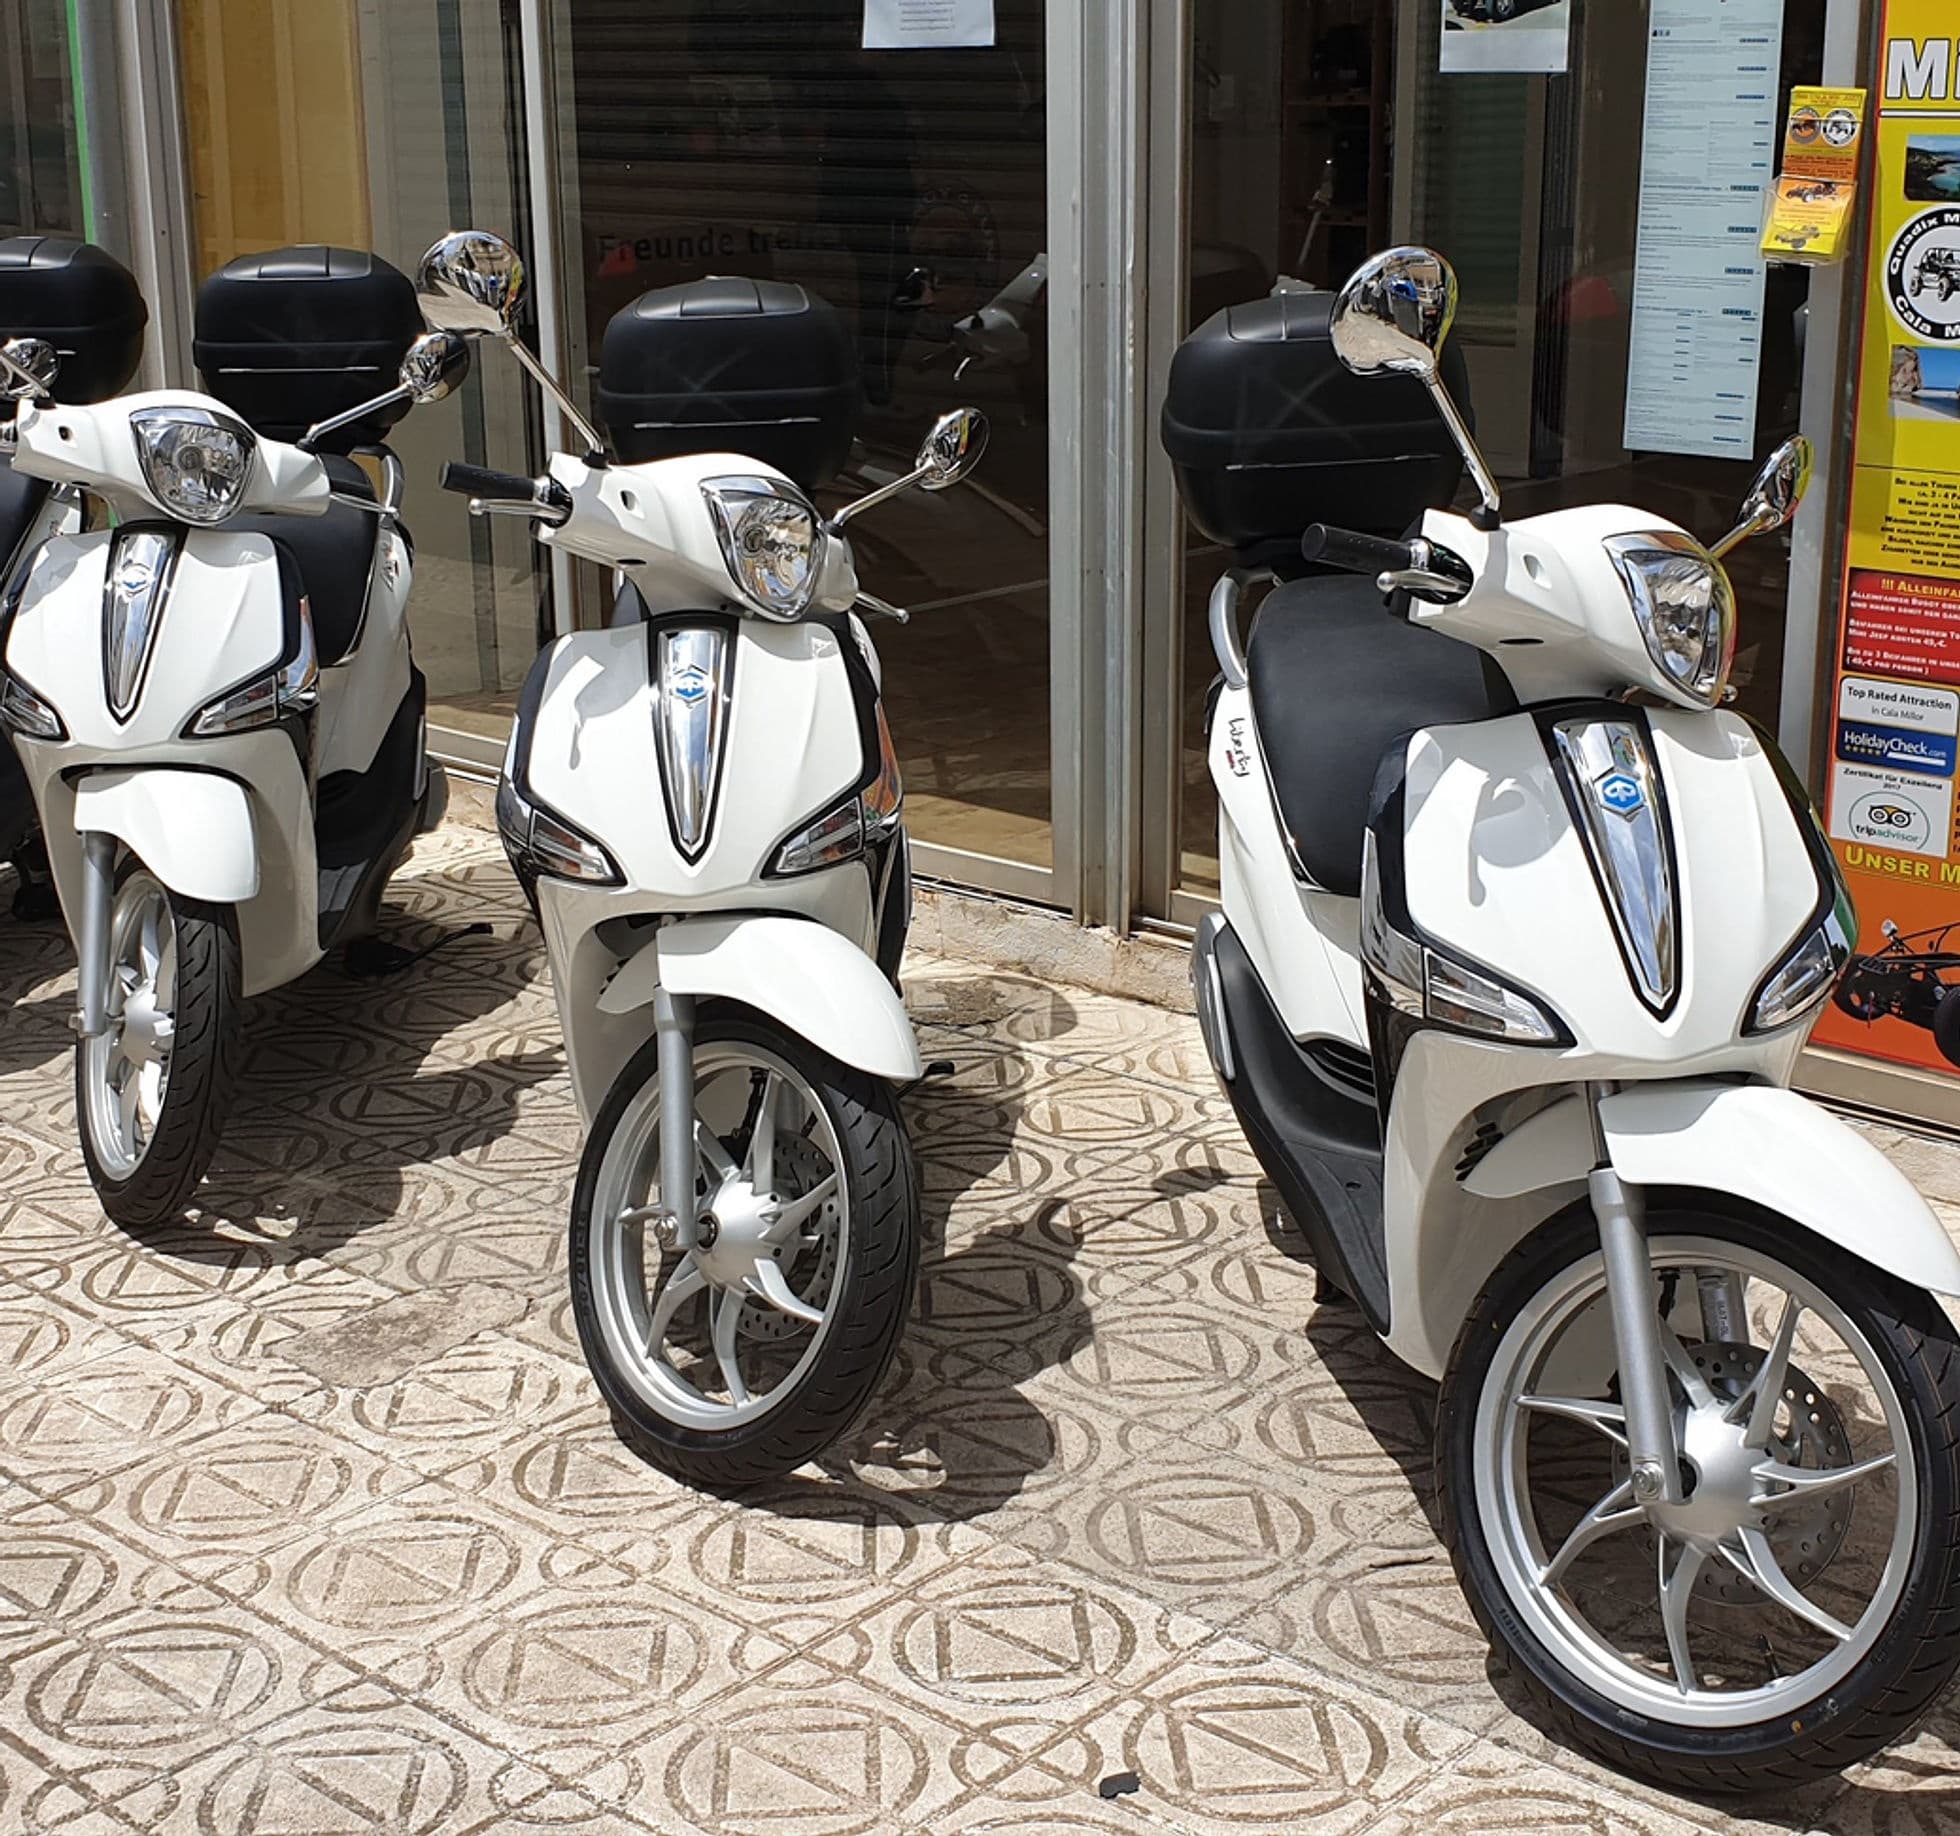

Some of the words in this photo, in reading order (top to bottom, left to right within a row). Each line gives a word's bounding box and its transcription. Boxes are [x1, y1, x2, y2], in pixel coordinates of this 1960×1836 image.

[598, 227, 734, 263] Freunde
[1890, 216, 1939, 276] Quadix
[1895, 294, 1932, 335] Cala
[1897, 580, 1960, 598] ALLEINFA
[1847, 685, 1866, 699] Top
[1867, 689, 1898, 702] Rated
[1899, 693, 1952, 710] Attraction
[1881, 706, 1899, 718] Cala
[1900, 709, 1924, 721] Millor
[1844, 730, 1947, 758] HolidayCheck.com
[1843, 767, 1884, 780] Zertifikat
[1855, 823, 1919, 843] tripadvisor
[1845, 844, 1931, 878] UNSER
